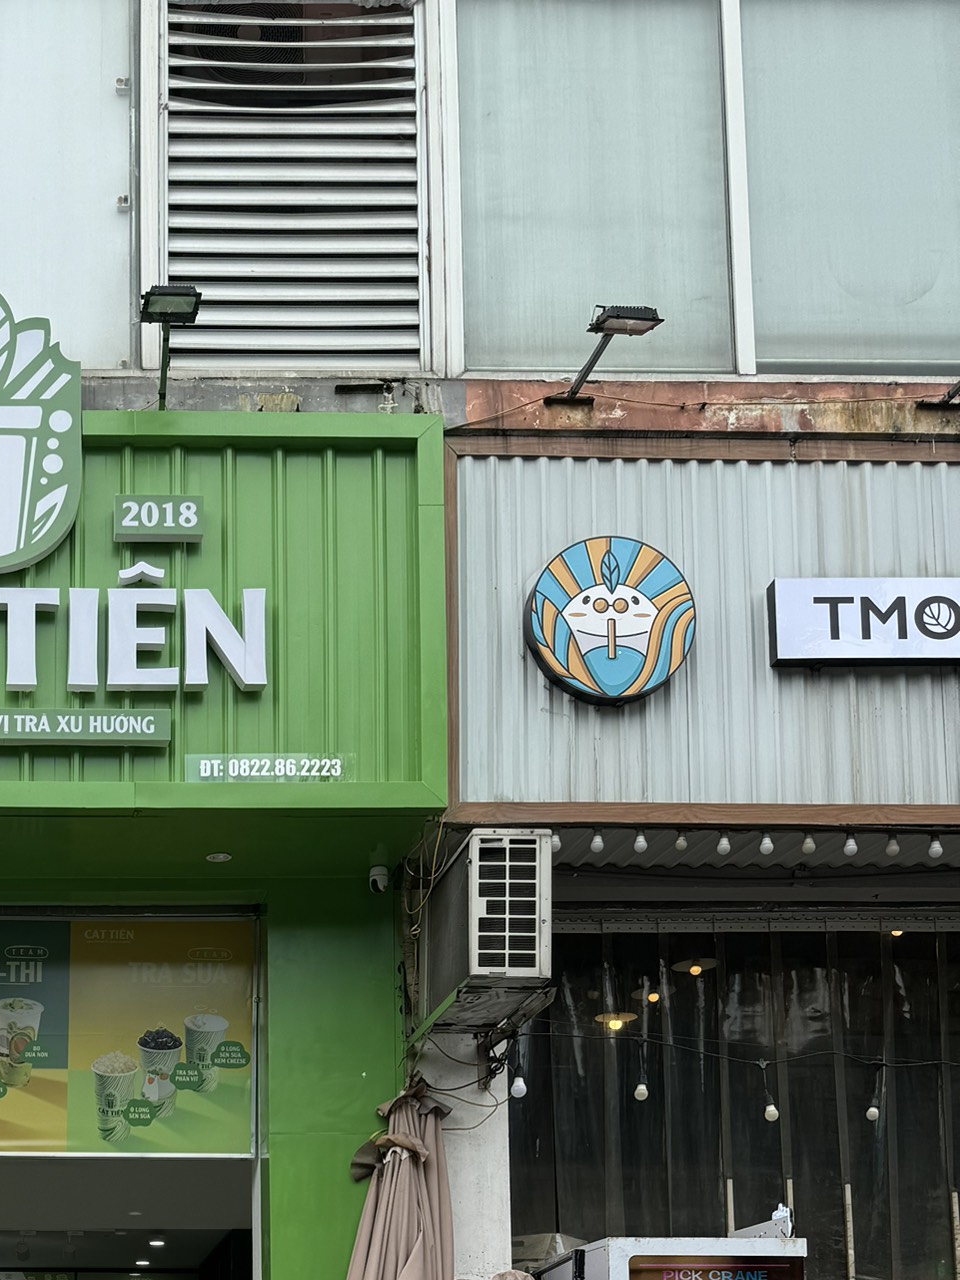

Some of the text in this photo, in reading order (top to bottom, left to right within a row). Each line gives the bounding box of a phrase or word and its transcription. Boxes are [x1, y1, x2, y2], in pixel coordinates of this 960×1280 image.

[121, 500, 198, 529] 2018
[14, 712, 50, 733] TRÀ
[56, 715, 83, 733] XU
[89, 711, 155, 734] HƯỚNG
[200, 758, 342, 777] ĐT: 0822.86.2223
[662, 1270, 703, 1280] PICK
